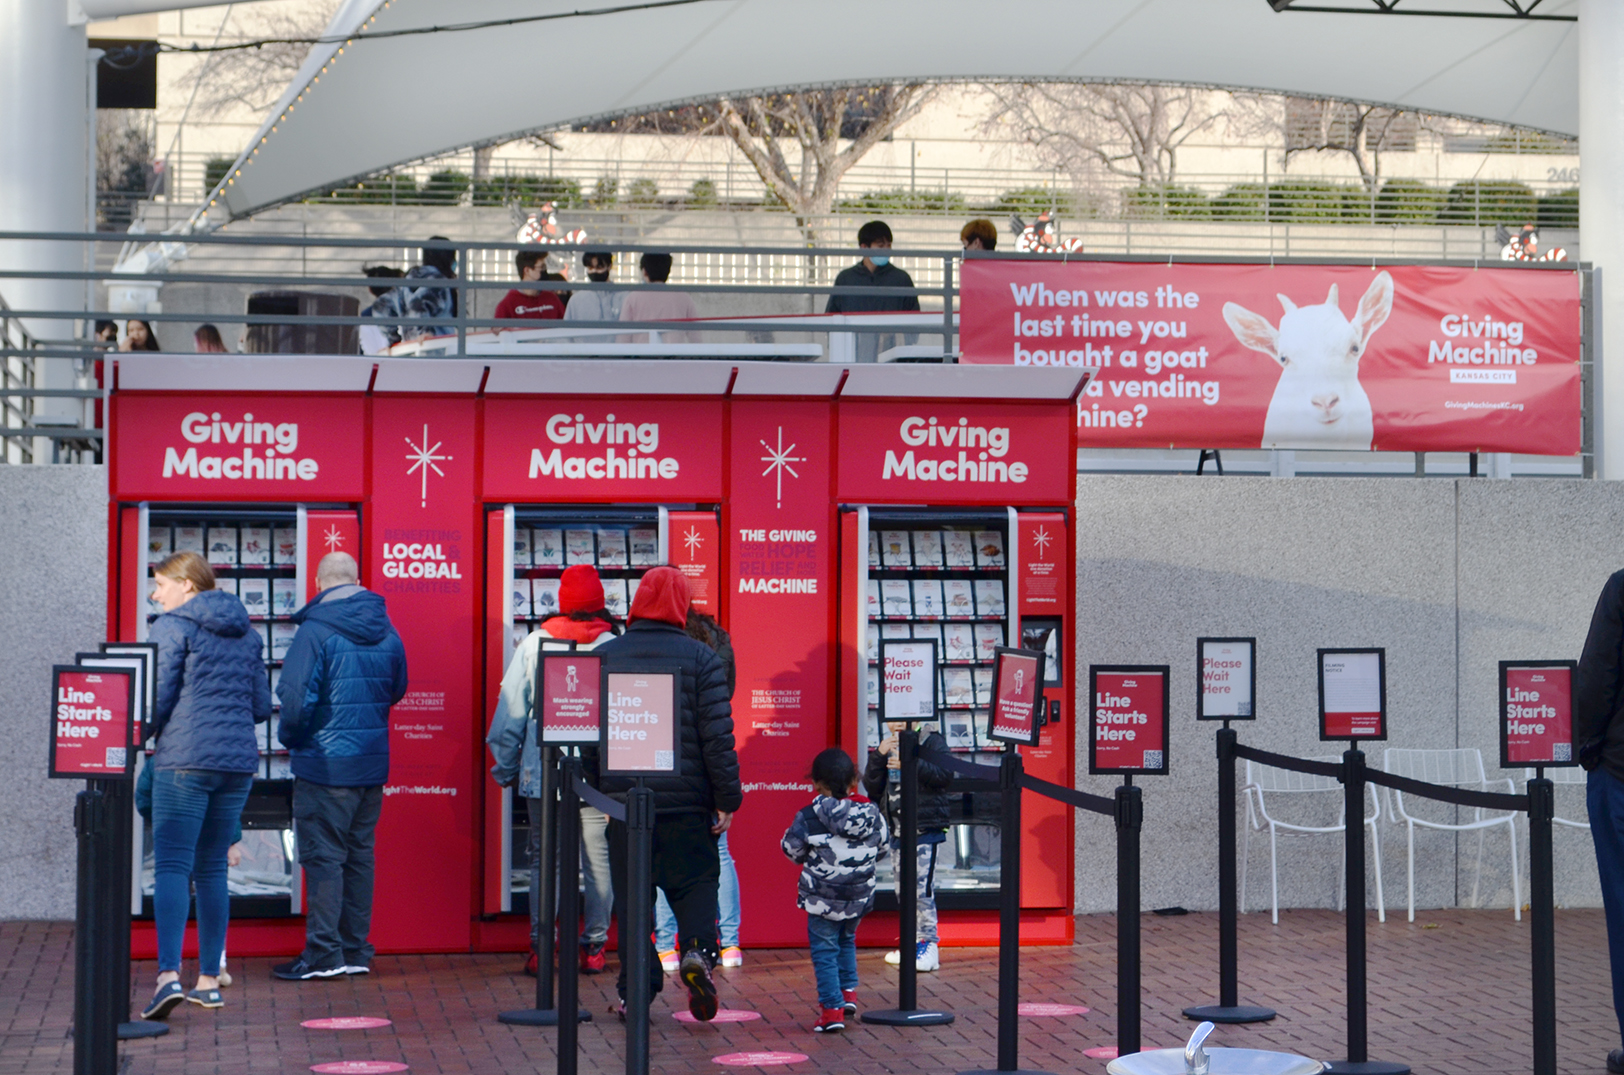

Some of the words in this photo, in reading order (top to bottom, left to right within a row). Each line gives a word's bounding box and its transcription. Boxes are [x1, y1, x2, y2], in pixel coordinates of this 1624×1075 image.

[1010, 282, 1088, 307] When
[1094, 290, 1149, 307] was
[1155, 284, 1200, 308] the
[1014, 312, 1065, 337] last
[1070, 313, 1132, 337] time
[1138, 320, 1187, 345] you
[1440, 314, 1524, 346] Giving
[1014, 342, 1113, 367] bought
[1119, 351, 1137, 368] a
[1144, 346, 1209, 375] goat
[1428, 340, 1538, 365] Machine
[1455, 372, 1490, 380] KANSAS
[1086, 380, 1103, 397] a
[1109, 373, 1220, 405] vending
[1077, 403, 1148, 428] hine?
[181, 412, 298, 453] Giving
[545, 413, 659, 454] Giving
[900, 416, 1010, 457] Giving
[162, 447, 319, 481] Machine
[528, 448, 680, 481] Machine
[882, 450, 1029, 483] Machine
[739, 529, 766, 542] THE
[769, 529, 817, 542] GIVING
[383, 543, 446, 560] LOCAL
[448, 545, 461, 560] &
[767, 543, 816, 559] HOPE
[382, 561, 462, 579] GLOBAL
[739, 561, 794, 576] RELIEF
[383, 581, 460, 593] CHARITIES
[738, 578, 817, 594] MACHINE
[884, 657, 924, 668] Please
[1203, 658, 1242, 668] Please
[884, 669, 911, 680] Wait
[1203, 670, 1230, 681] Wait
[58, 686, 95, 703] Line
[884, 683, 913, 693] Here
[1203, 683, 1231, 694] Here
[1507, 687, 1540, 702] Line
[415, 698, 445, 706] CHRIST
[569, 697, 593, 705] wearing
[608, 692, 642, 707] Line
[1096, 692, 1131, 708] Line
[57, 704, 112, 721] Starts
[608, 709, 658, 724] Starts
[1096, 709, 1147, 724] Starts
[1507, 704, 1556, 718] Starts
[57, 721, 99, 738] Here
[394, 723, 425, 731] Latter-day
[752, 721, 782, 729] Latter-day
[1507, 720, 1545, 735] Here
[608, 726, 647, 741] Here
[1096, 726, 1136, 741] Here
[382, 786, 457, 796] ightTheWorld.org
[741, 782, 814, 793] ightTheWorld.org
